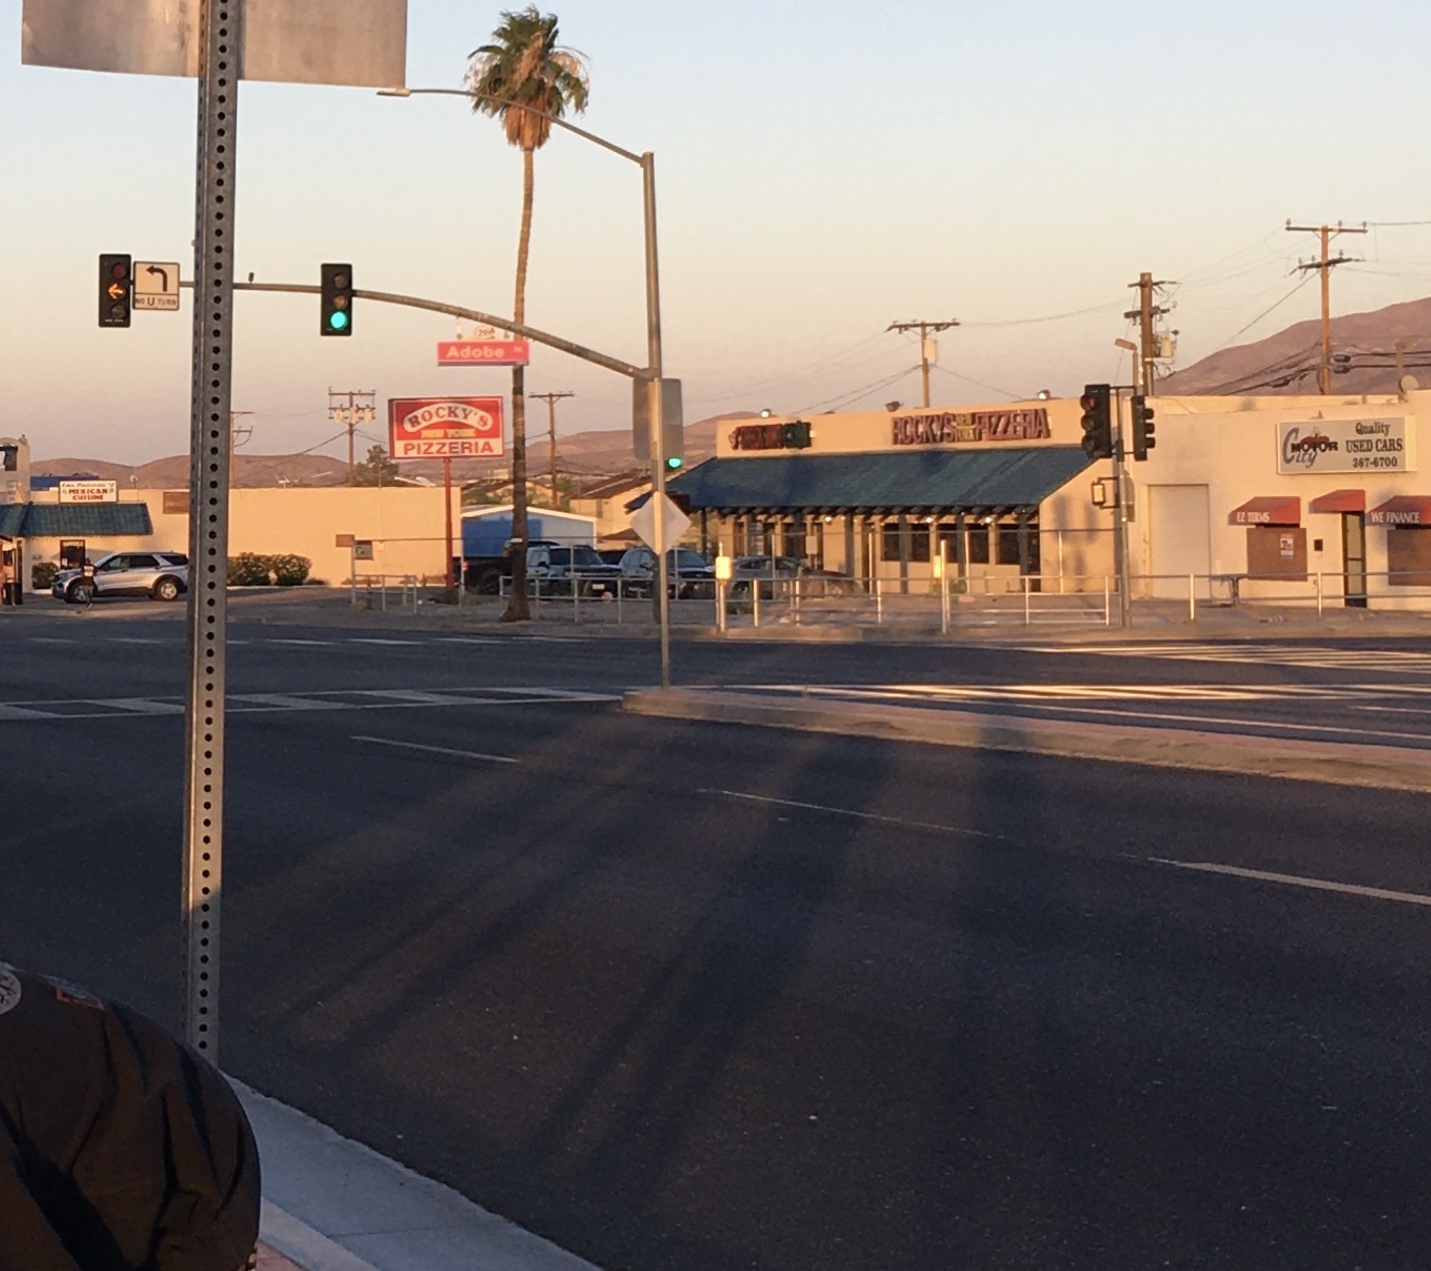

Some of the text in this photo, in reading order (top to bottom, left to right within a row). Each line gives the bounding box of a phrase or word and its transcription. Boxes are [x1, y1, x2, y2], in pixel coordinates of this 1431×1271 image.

[147, 297, 155, 306] U
[157, 298, 177, 306] TURN
[446, 346, 505, 359] Adobe
[407, 406, 489, 429] ROCKY'S
[973, 408, 1051, 441] PIZZERIA
[1355, 422, 1391, 436] Quality
[403, 441, 494, 456] PIZZERIA
[1291, 441, 1339, 453] MOTOR
[1345, 438, 1403, 453] USED CARS
[1353, 456, 1398, 468] 367-6700
[1237, 512, 1270, 523] EZ TERMS
[1371, 512, 1420, 524] WE FINANCE
